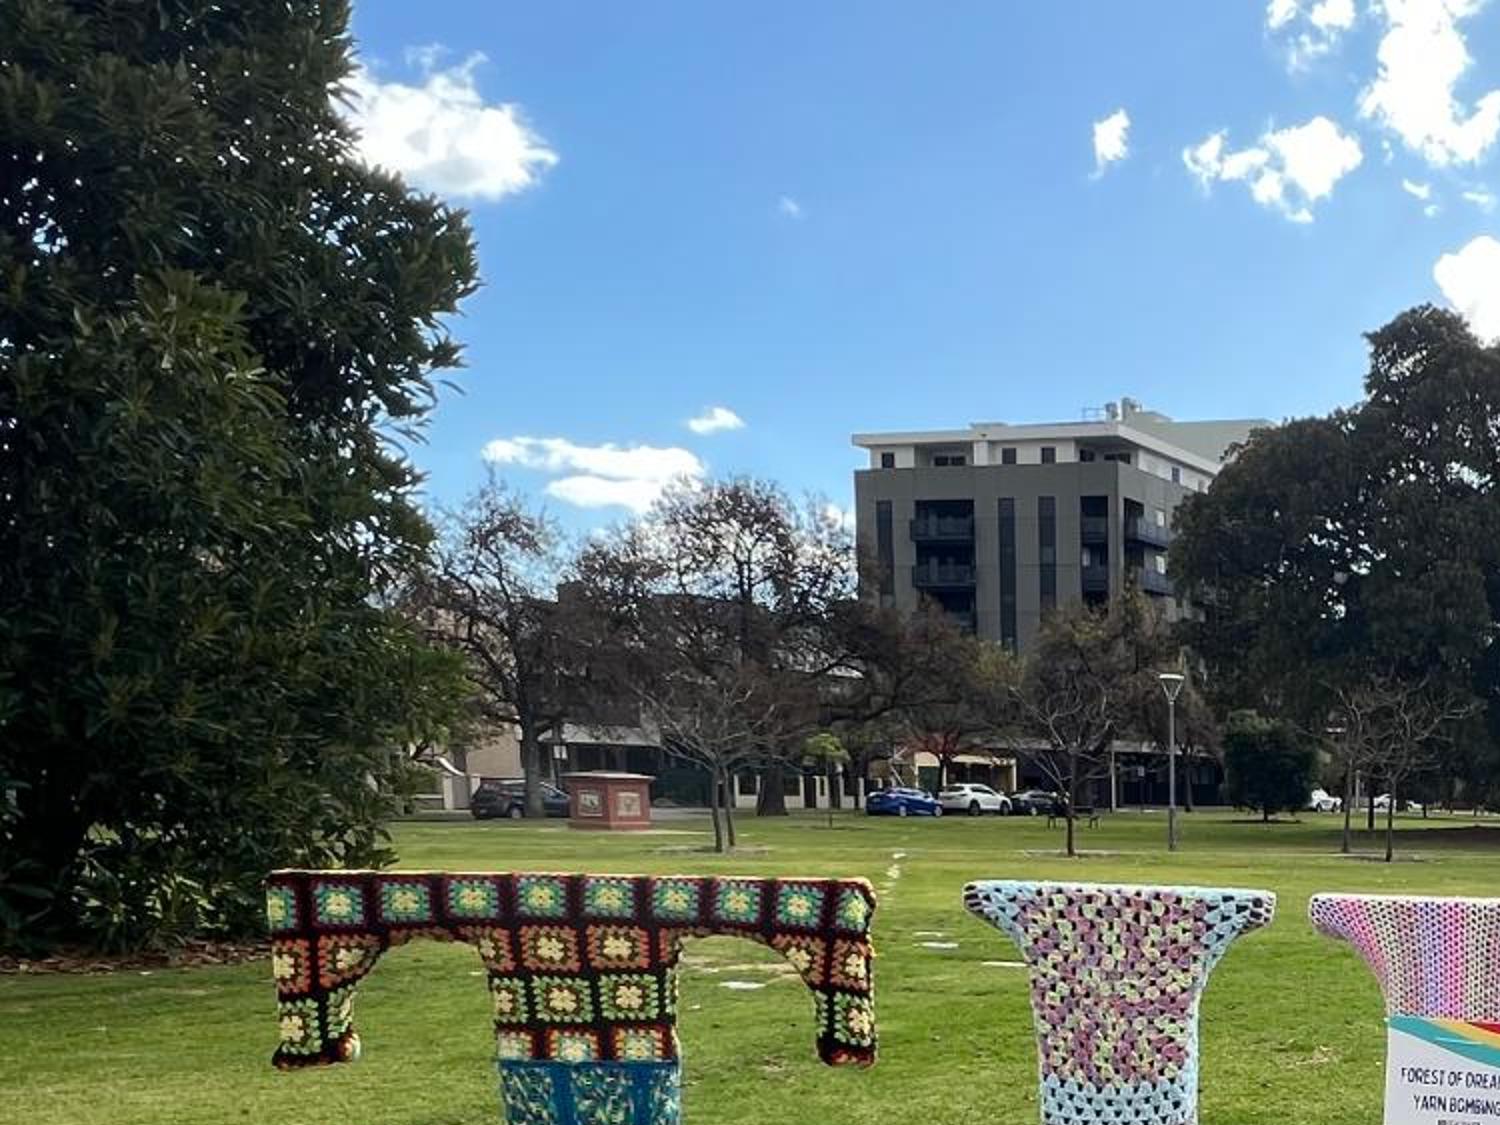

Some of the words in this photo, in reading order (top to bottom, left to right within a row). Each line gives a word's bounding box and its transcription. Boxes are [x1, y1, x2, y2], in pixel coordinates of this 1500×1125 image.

[1401, 1067, 1444, 1086] FOREST
[1447, 1071, 1463, 1087] OF
[1413, 1095, 1447, 1113] YARN
